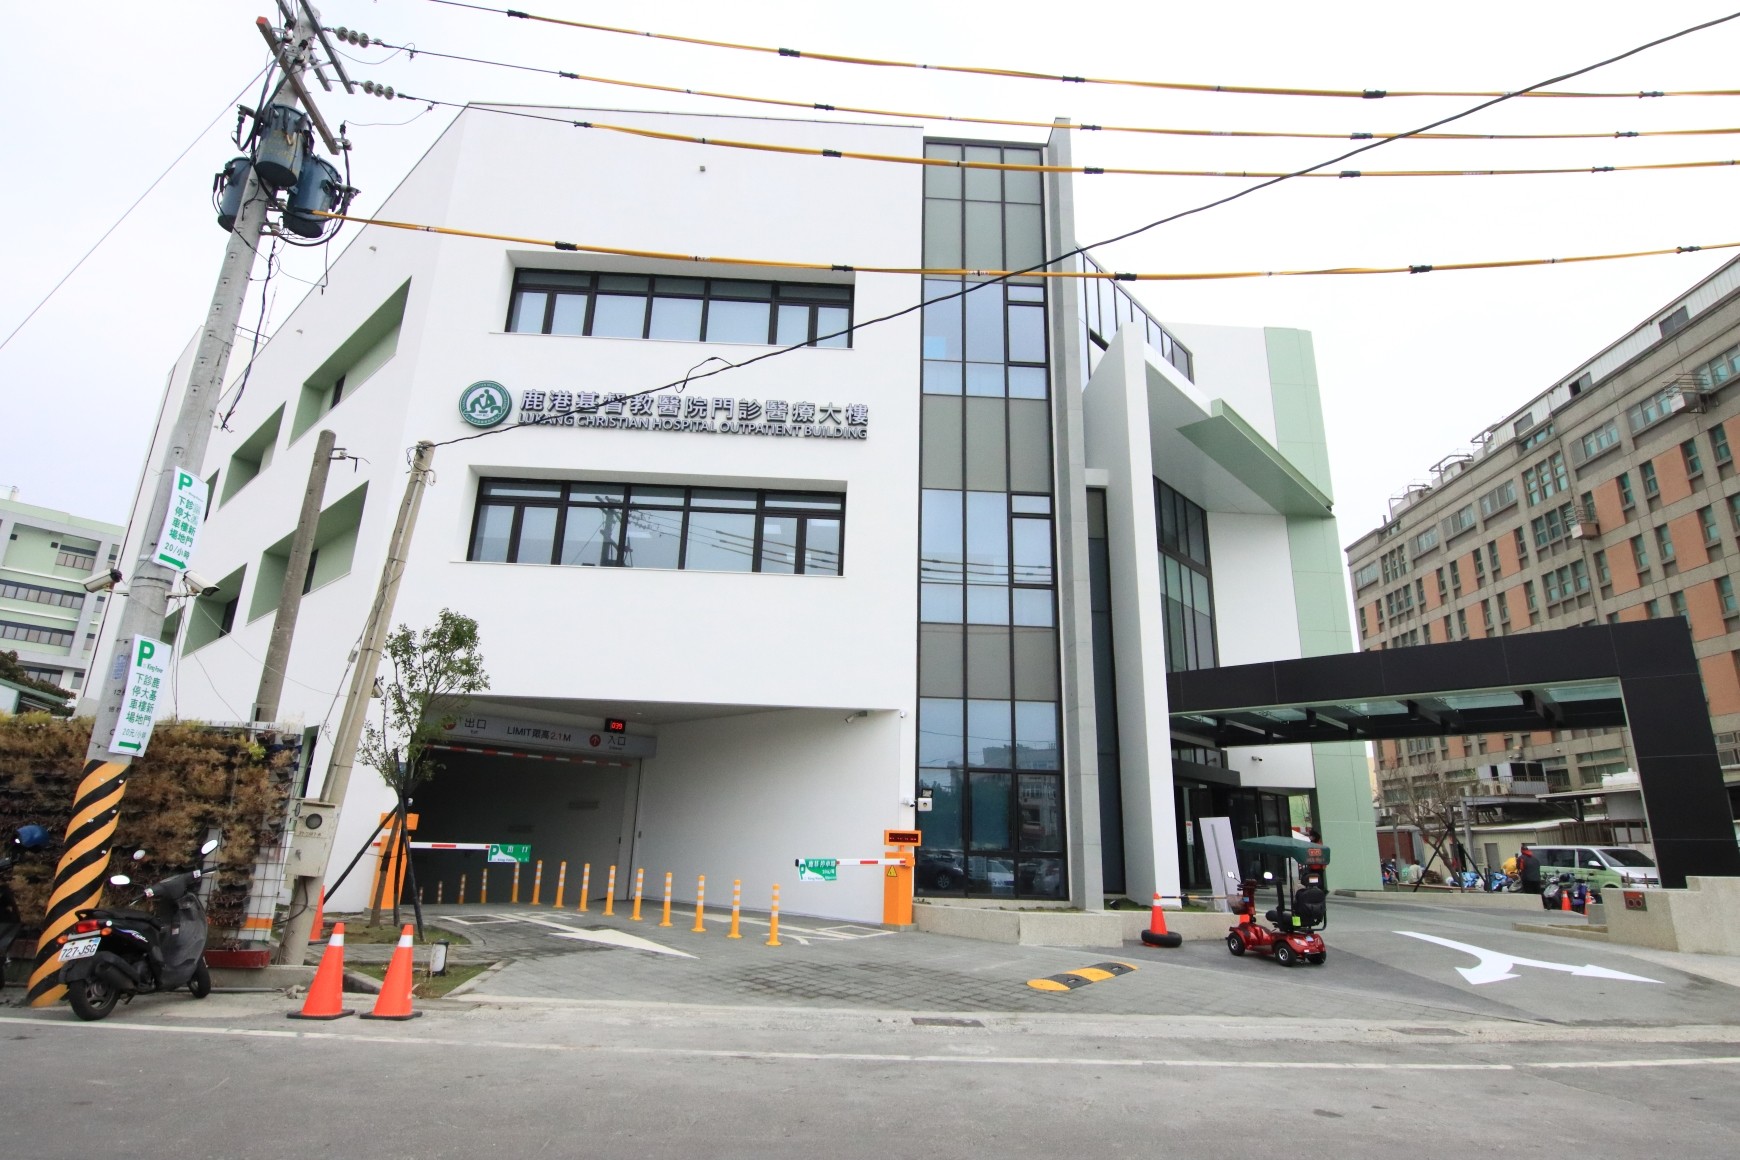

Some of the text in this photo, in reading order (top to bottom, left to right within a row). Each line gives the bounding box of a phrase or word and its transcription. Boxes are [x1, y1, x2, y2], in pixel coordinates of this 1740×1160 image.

[520, 389, 869, 426] 鹿港基督教醫院門診醫療大樓
[518, 412, 868, 440] LUKANG CHRISTIAN HOSPITAL OUTPATIENT BUILDING
[178, 472, 193, 491] P
[136, 640, 155, 667] P
[464, 717, 487, 730] 出口
[607, 735, 626, 746] 入口
[62, 943, 97, 959] 727-JSG
